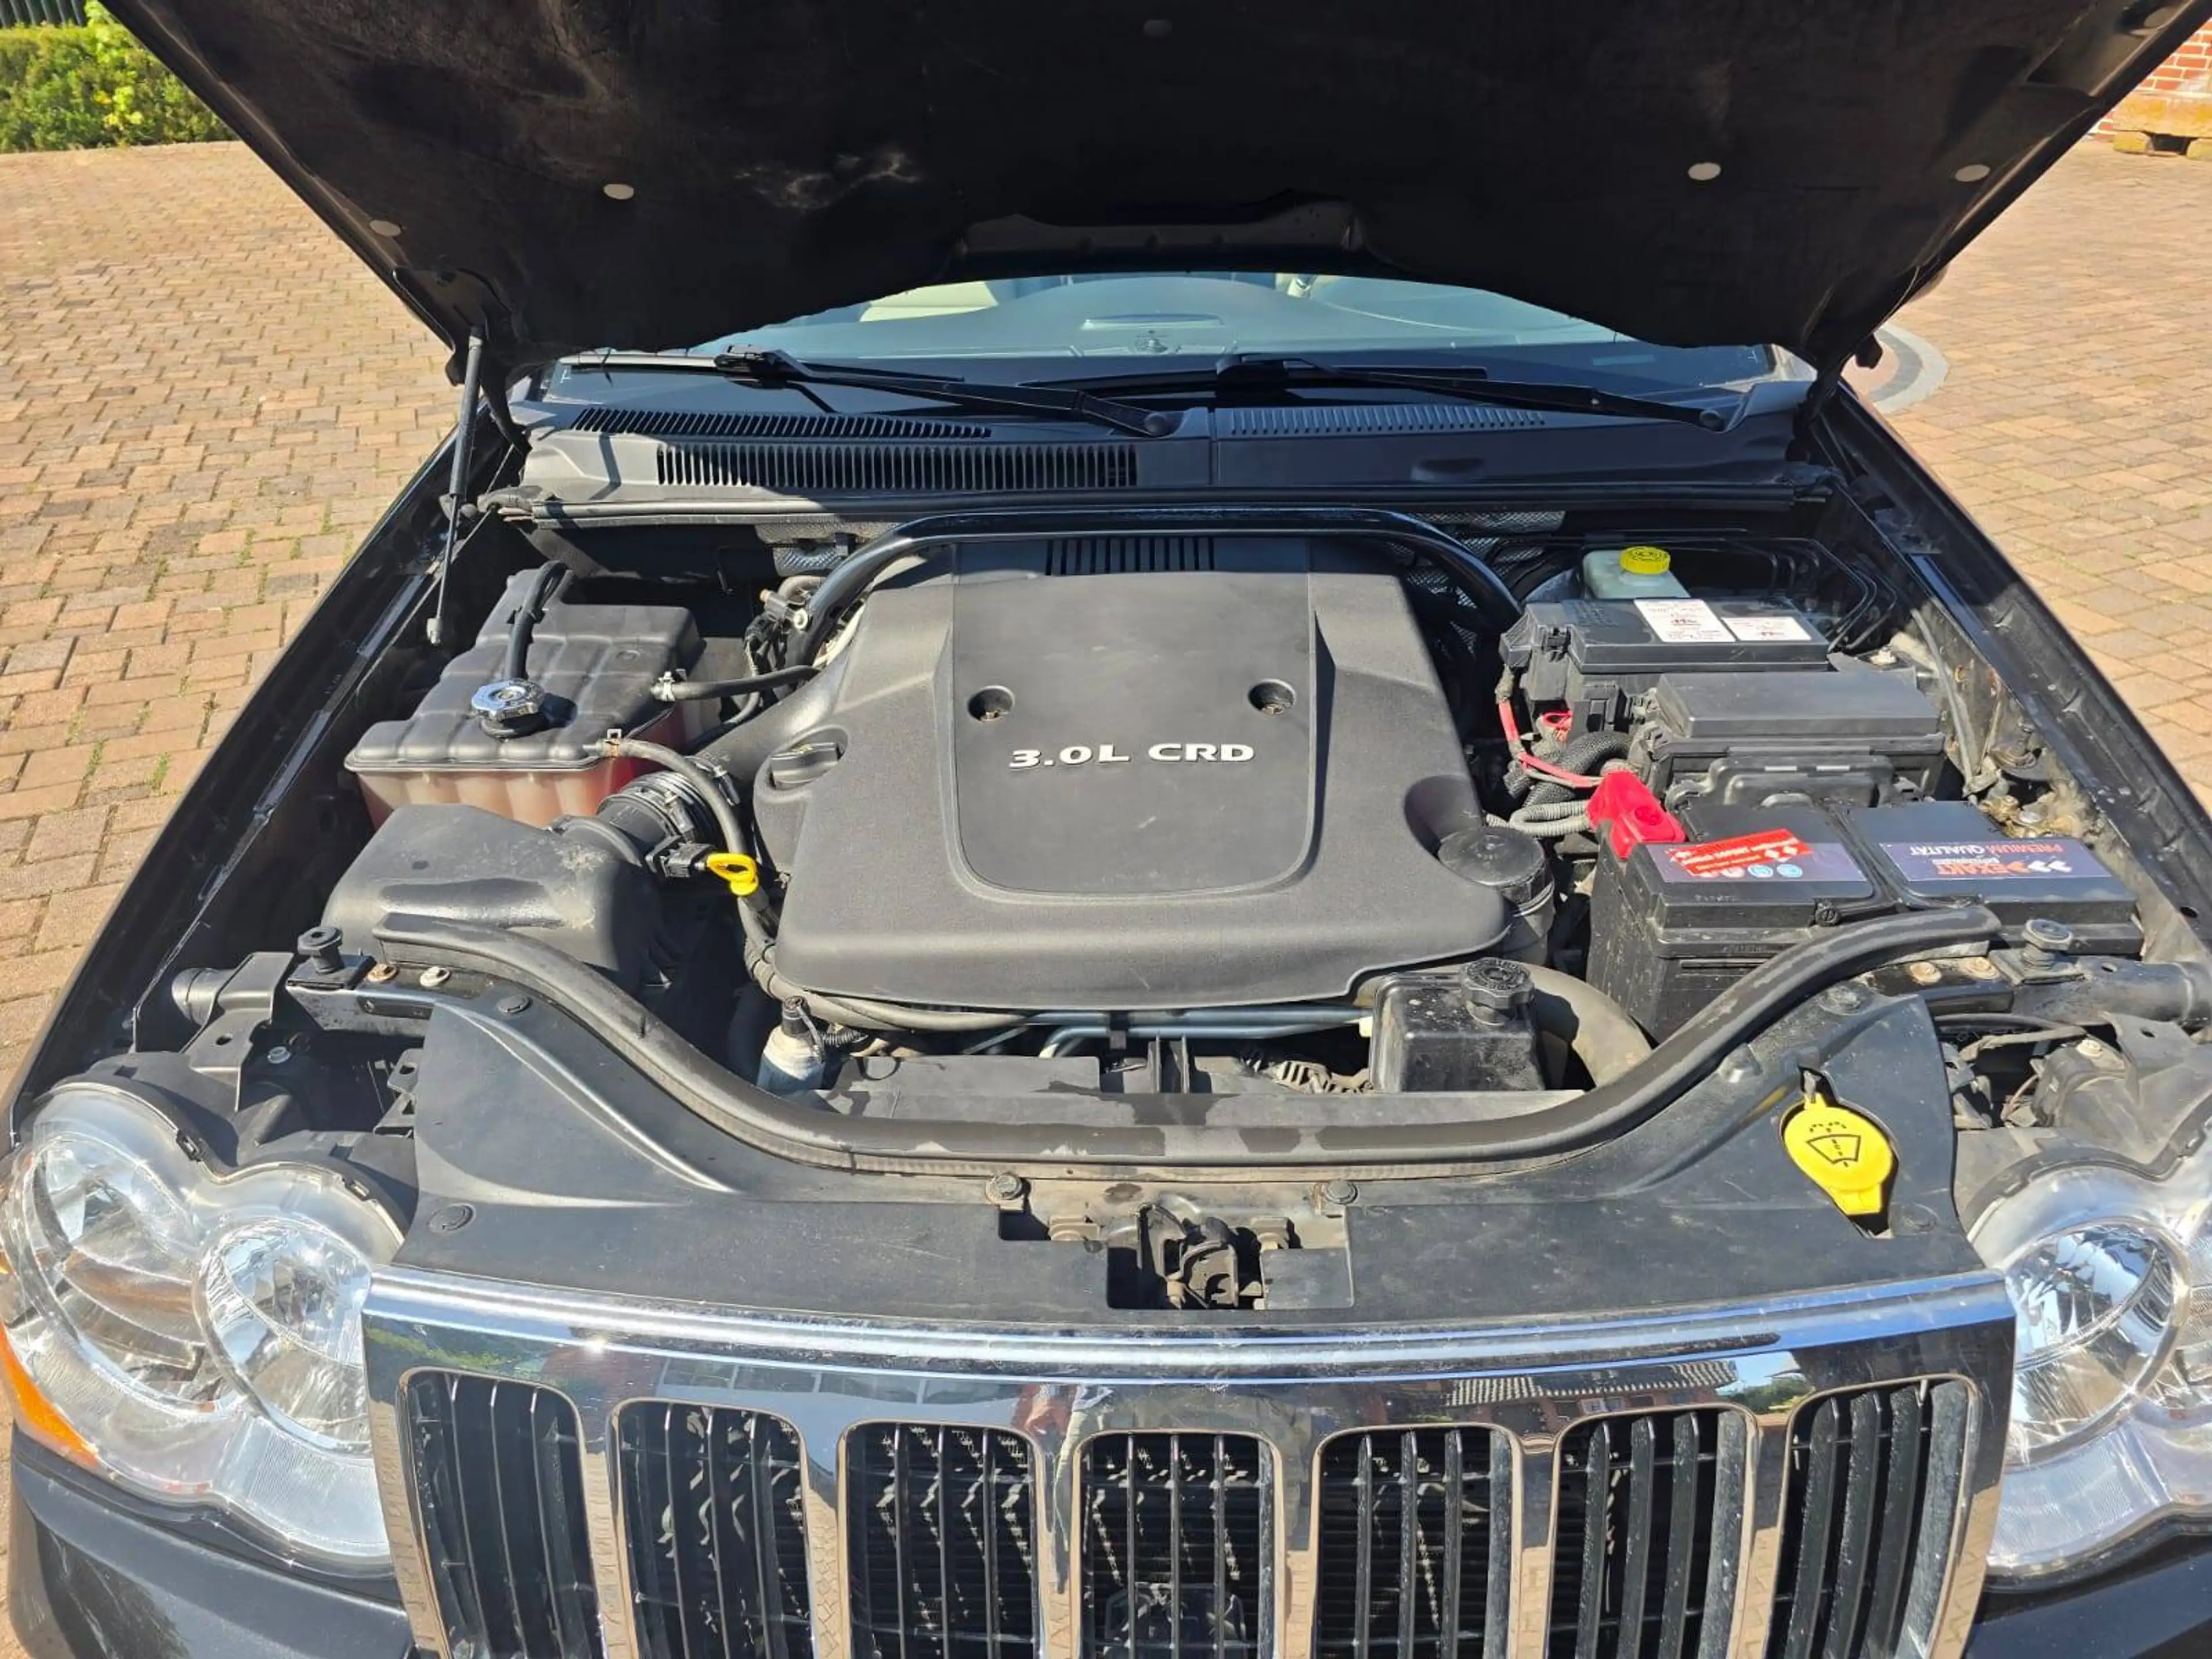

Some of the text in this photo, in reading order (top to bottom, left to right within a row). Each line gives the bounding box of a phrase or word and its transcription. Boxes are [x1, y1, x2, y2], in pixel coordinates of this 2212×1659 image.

[1009, 743, 1255, 768] 3.0L CRD
[1987, 844, 2063, 854] PREMIUM
